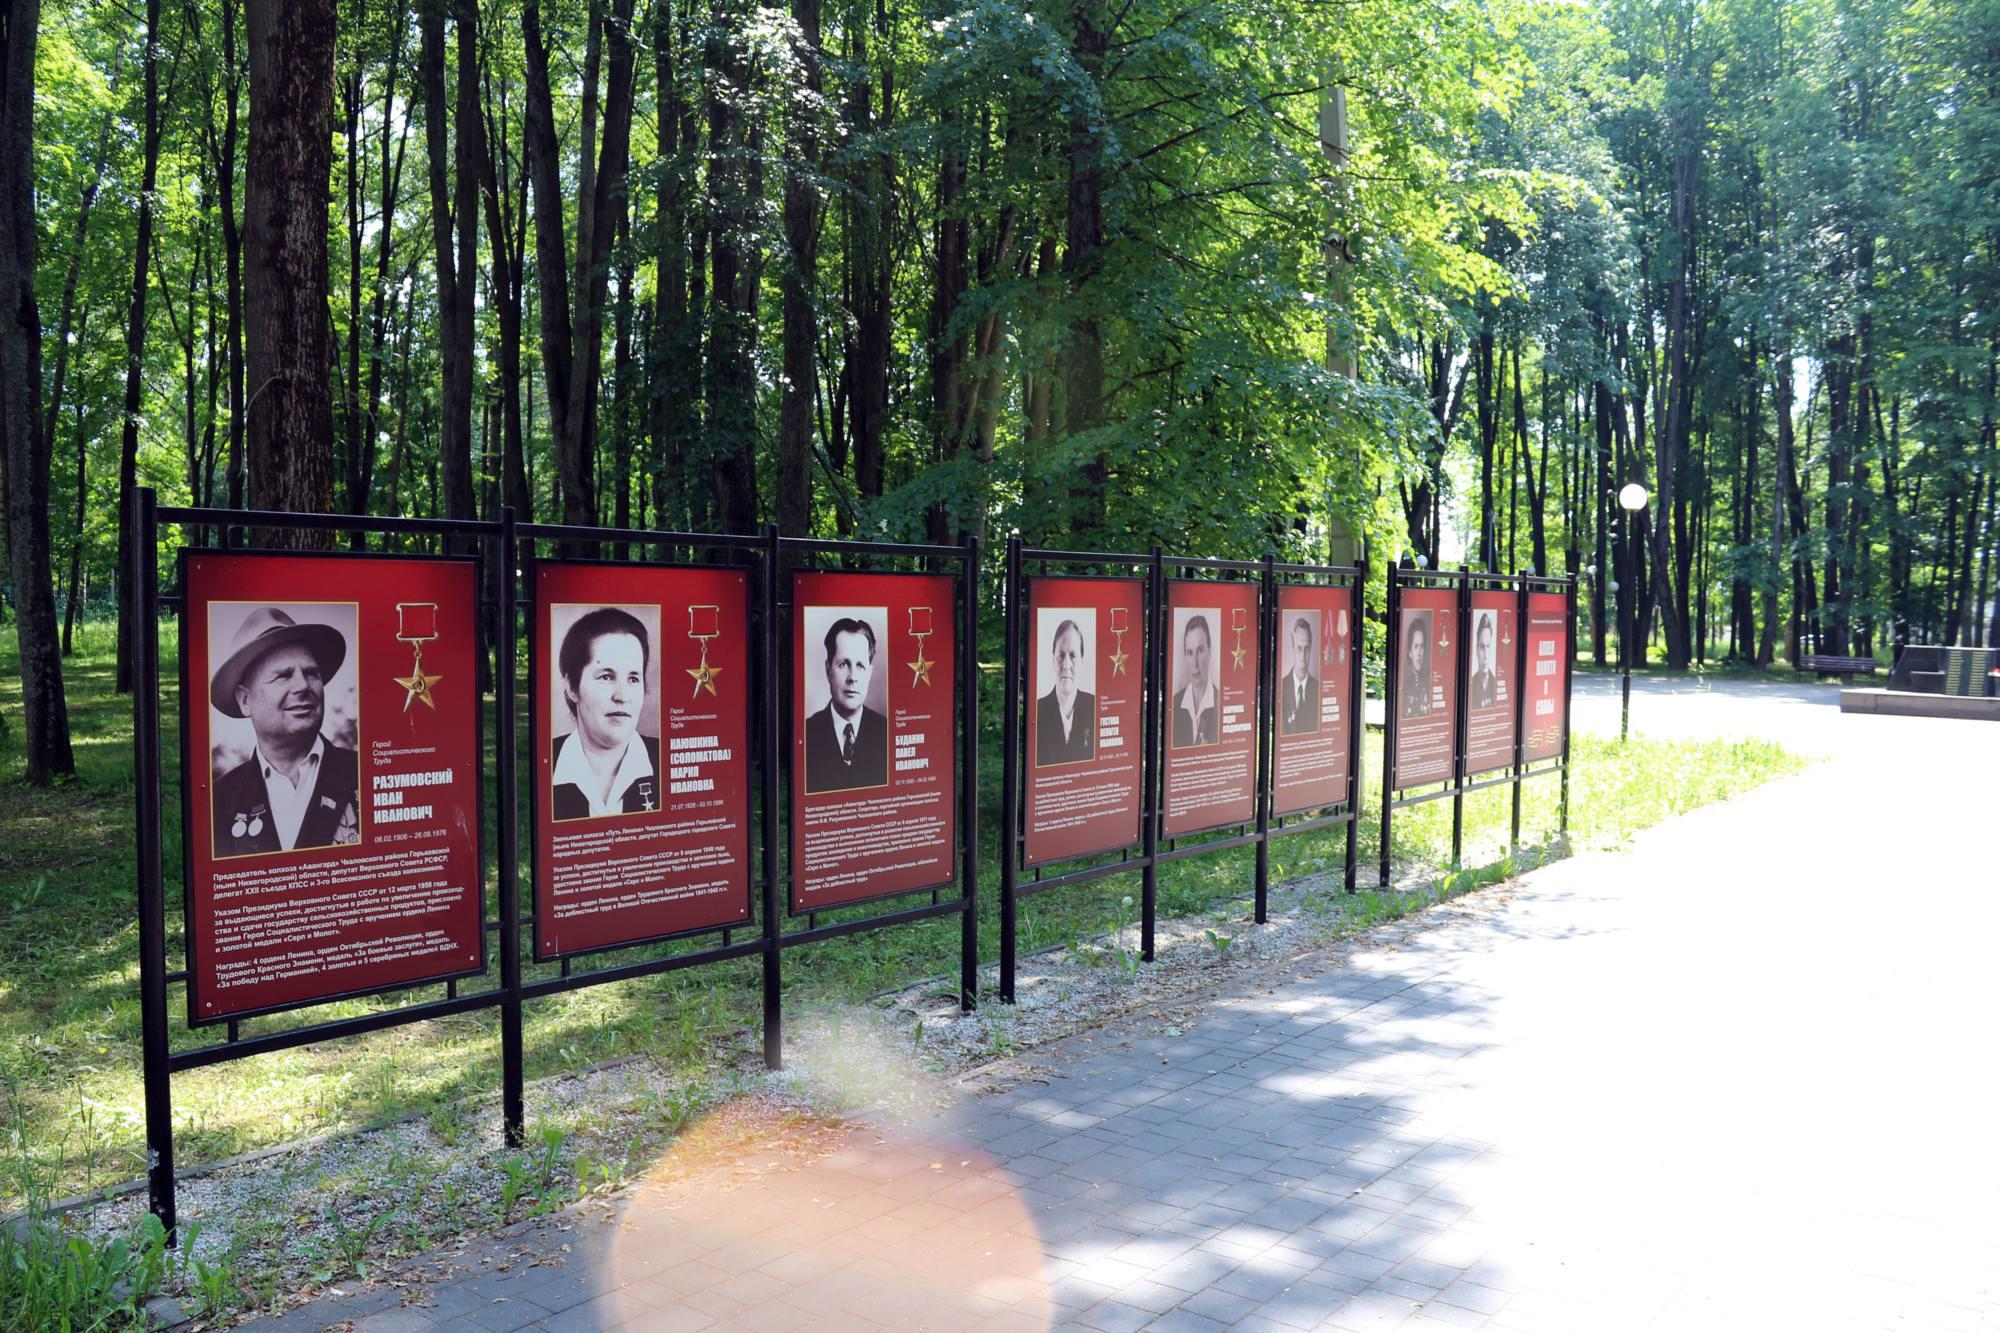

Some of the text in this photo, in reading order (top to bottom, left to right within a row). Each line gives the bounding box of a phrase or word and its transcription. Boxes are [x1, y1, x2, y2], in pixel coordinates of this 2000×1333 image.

[670, 736, 719, 750] КАЮШКИНА
[670, 749, 731, 765] (СОЛОМАТОВА)
[373, 768, 453, 790] РАЗУМОВСКИЙ
[670, 766, 699, 779] МАРИЯ
[670, 779, 714, 794] ИВАНОВНА
[374, 791, 403, 807] ИВАН
[374, 805, 432, 824] ИВАНОВИЧ
[213, 870, 266, 880] Председатель
[340, 856, 383, 864] Чкаловского
[384, 853, 408, 861] района
[409, 847, 449, 857] Горьковской
[213, 882, 236, 890] (ныне
[330, 867, 358, 875] депутат
[359, 862, 398, 871] Верховного
[213, 890, 242, 899] делегат
[288, 880, 308, 888] КПСС
[331, 873, 376, 883] Всесоюзного
[224, 913, 274, 924] выдающиеся
[304, 902, 349, 913] достигнутые
[356, 898, 379, 906] работе
[391, 891, 430, 902] увеличению
[242, 902, 287, 913] Президиума
[289, 896, 330, 906] Верховного
[358, 888, 377, 896] СССР
[263, 917, 308, 927] государству
[427, 895, 461, 904] присвоено
[214, 935, 241, 943] звание
[365, 912, 400, 921] вручением
[402, 908, 425, 916] ордена
[222, 941, 252, 951] золотой
[254, 938, 281, 946] медали
[259, 955, 285, 964] ордена
[339, 940, 383, 950] Октябрьской
[216, 968, 255, 979] Трудового
[257, 963, 290, 973] Красного
[367, 946, 392, 954] боевые
[231, 977, 258, 985] победу
[327, 960, 356, 969] золотые
[369, 951, 409, 962] серебряных
[410, 946, 438, 955] медалей
